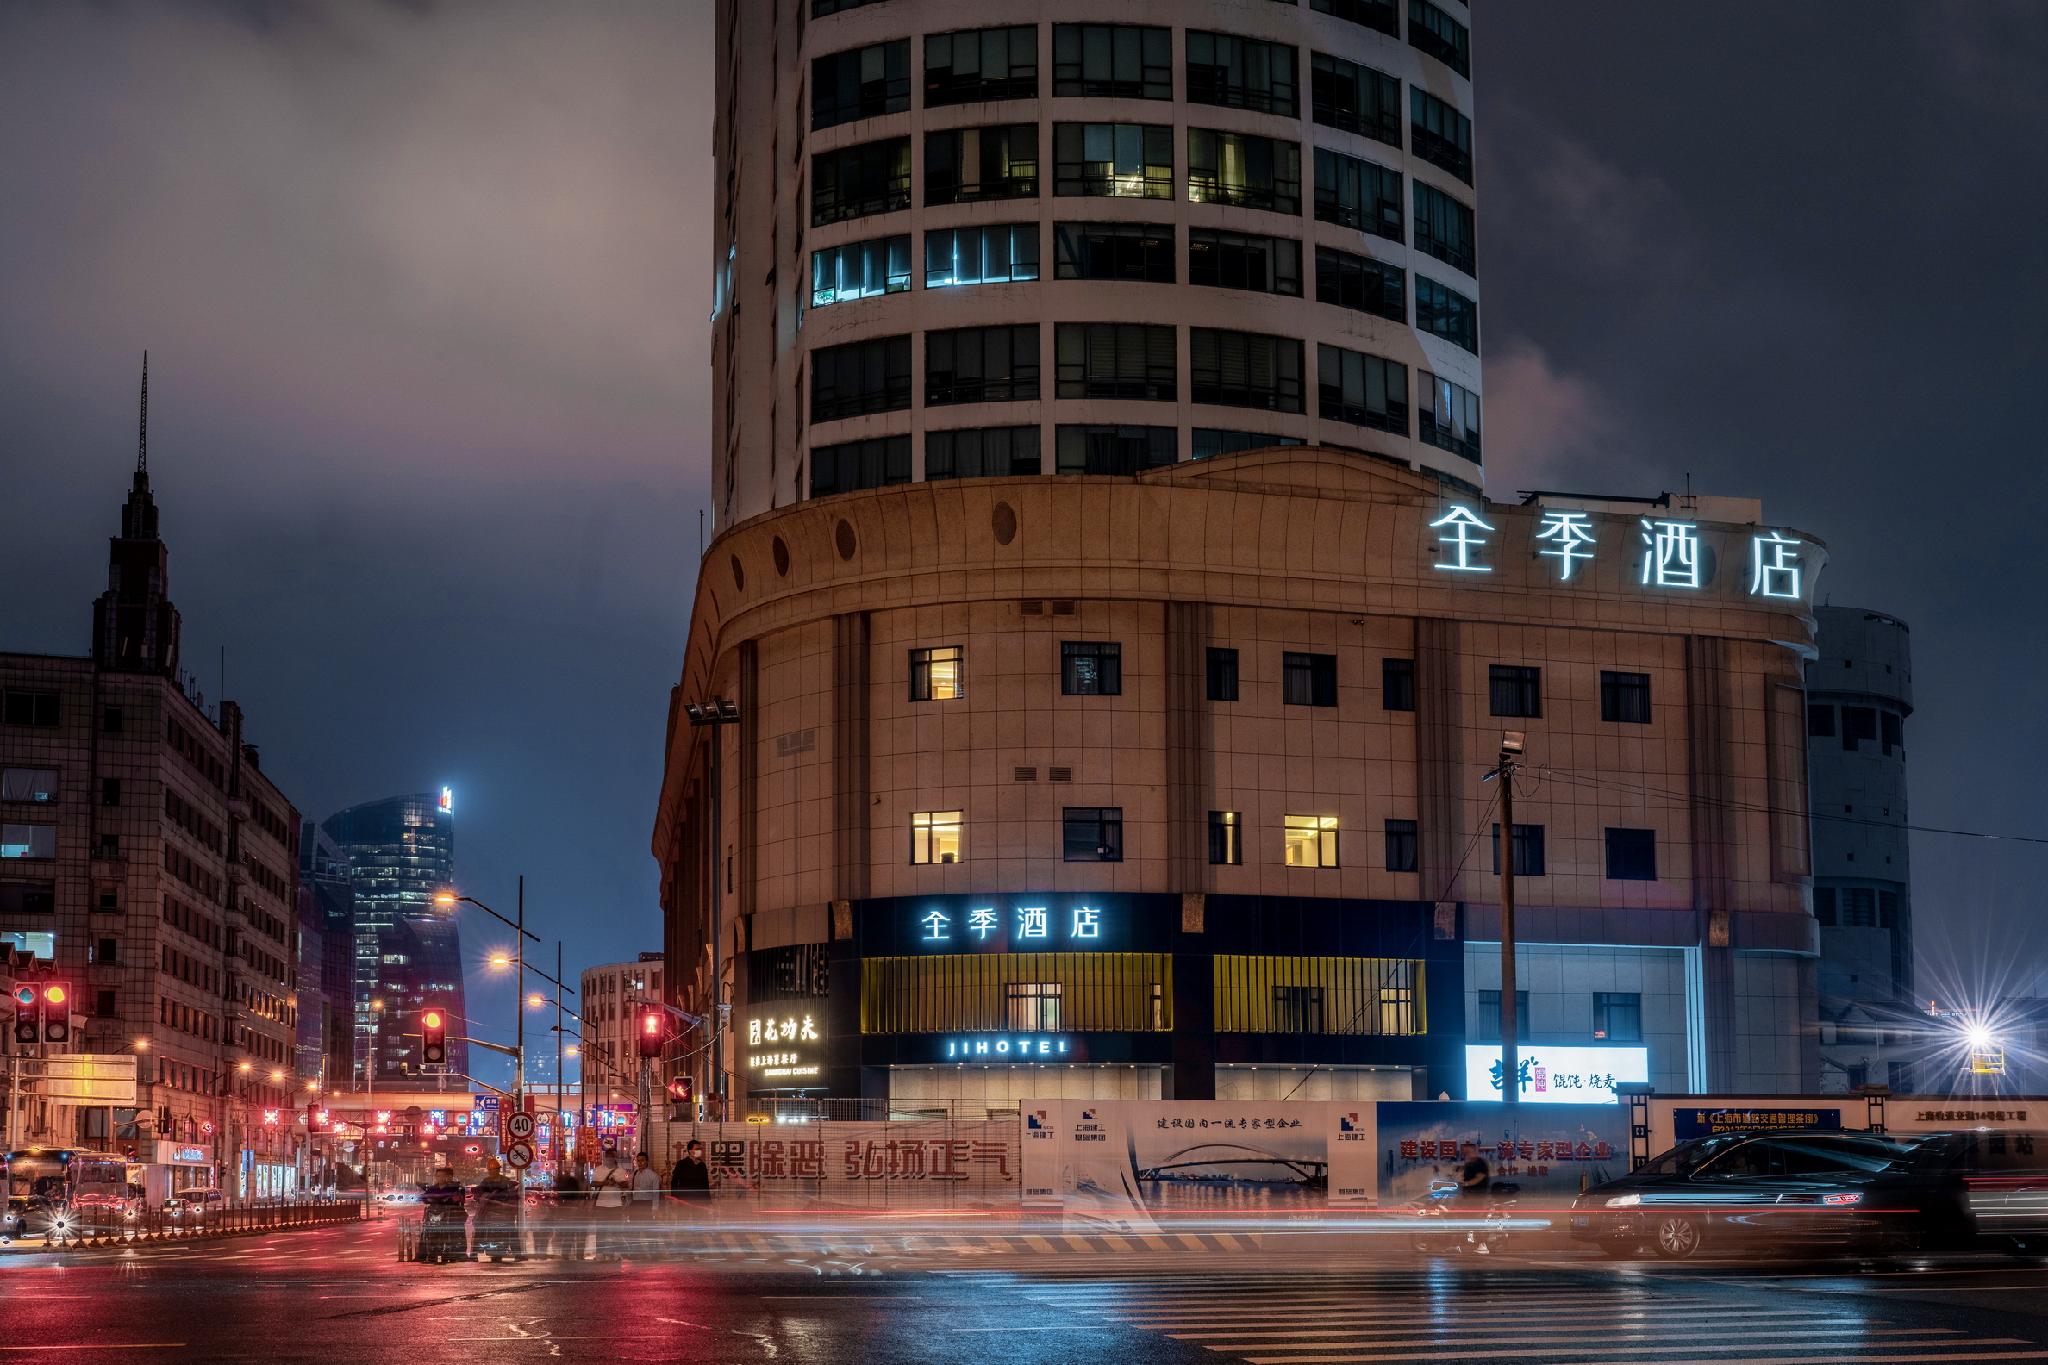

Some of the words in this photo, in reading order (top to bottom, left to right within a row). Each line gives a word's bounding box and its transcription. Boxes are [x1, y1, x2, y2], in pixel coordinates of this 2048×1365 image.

[1428, 504, 1802, 599] 全季酒店
[921, 906, 1101, 940] 全季酒店
[514, 1118, 529, 1132] 40
[1157, 1118, 1303, 1129] 建设国内一流专家型企业
[844, 1140, 1013, 1181] 弘扬正气
